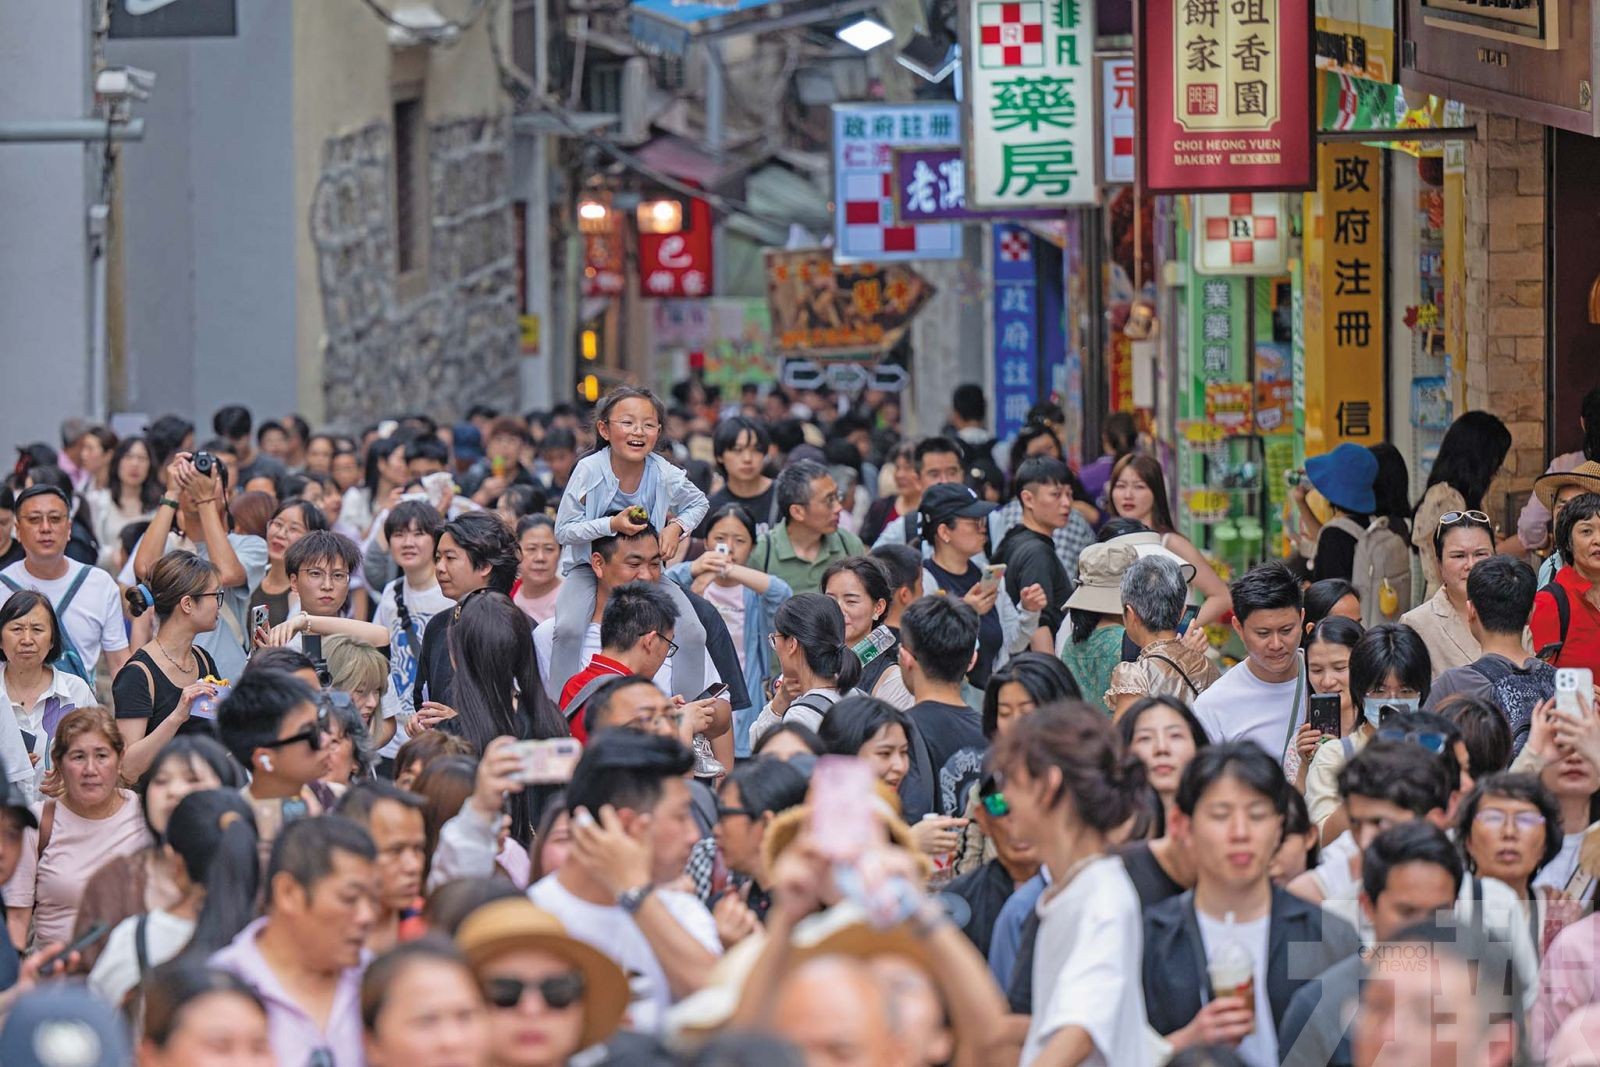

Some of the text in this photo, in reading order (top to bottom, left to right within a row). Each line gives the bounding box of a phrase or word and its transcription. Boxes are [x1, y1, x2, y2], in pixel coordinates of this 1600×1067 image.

[1185, 0, 1222, 72] 餅家
[1231, 0, 1270, 117] 咀香園
[989, 75, 1078, 197] 藥房
[1173, 139, 1281, 151] CHOI HEONG YUEN
[1174, 153, 1277, 165] BAKERY MACAU
[1335, 401, 1371, 437] 信
